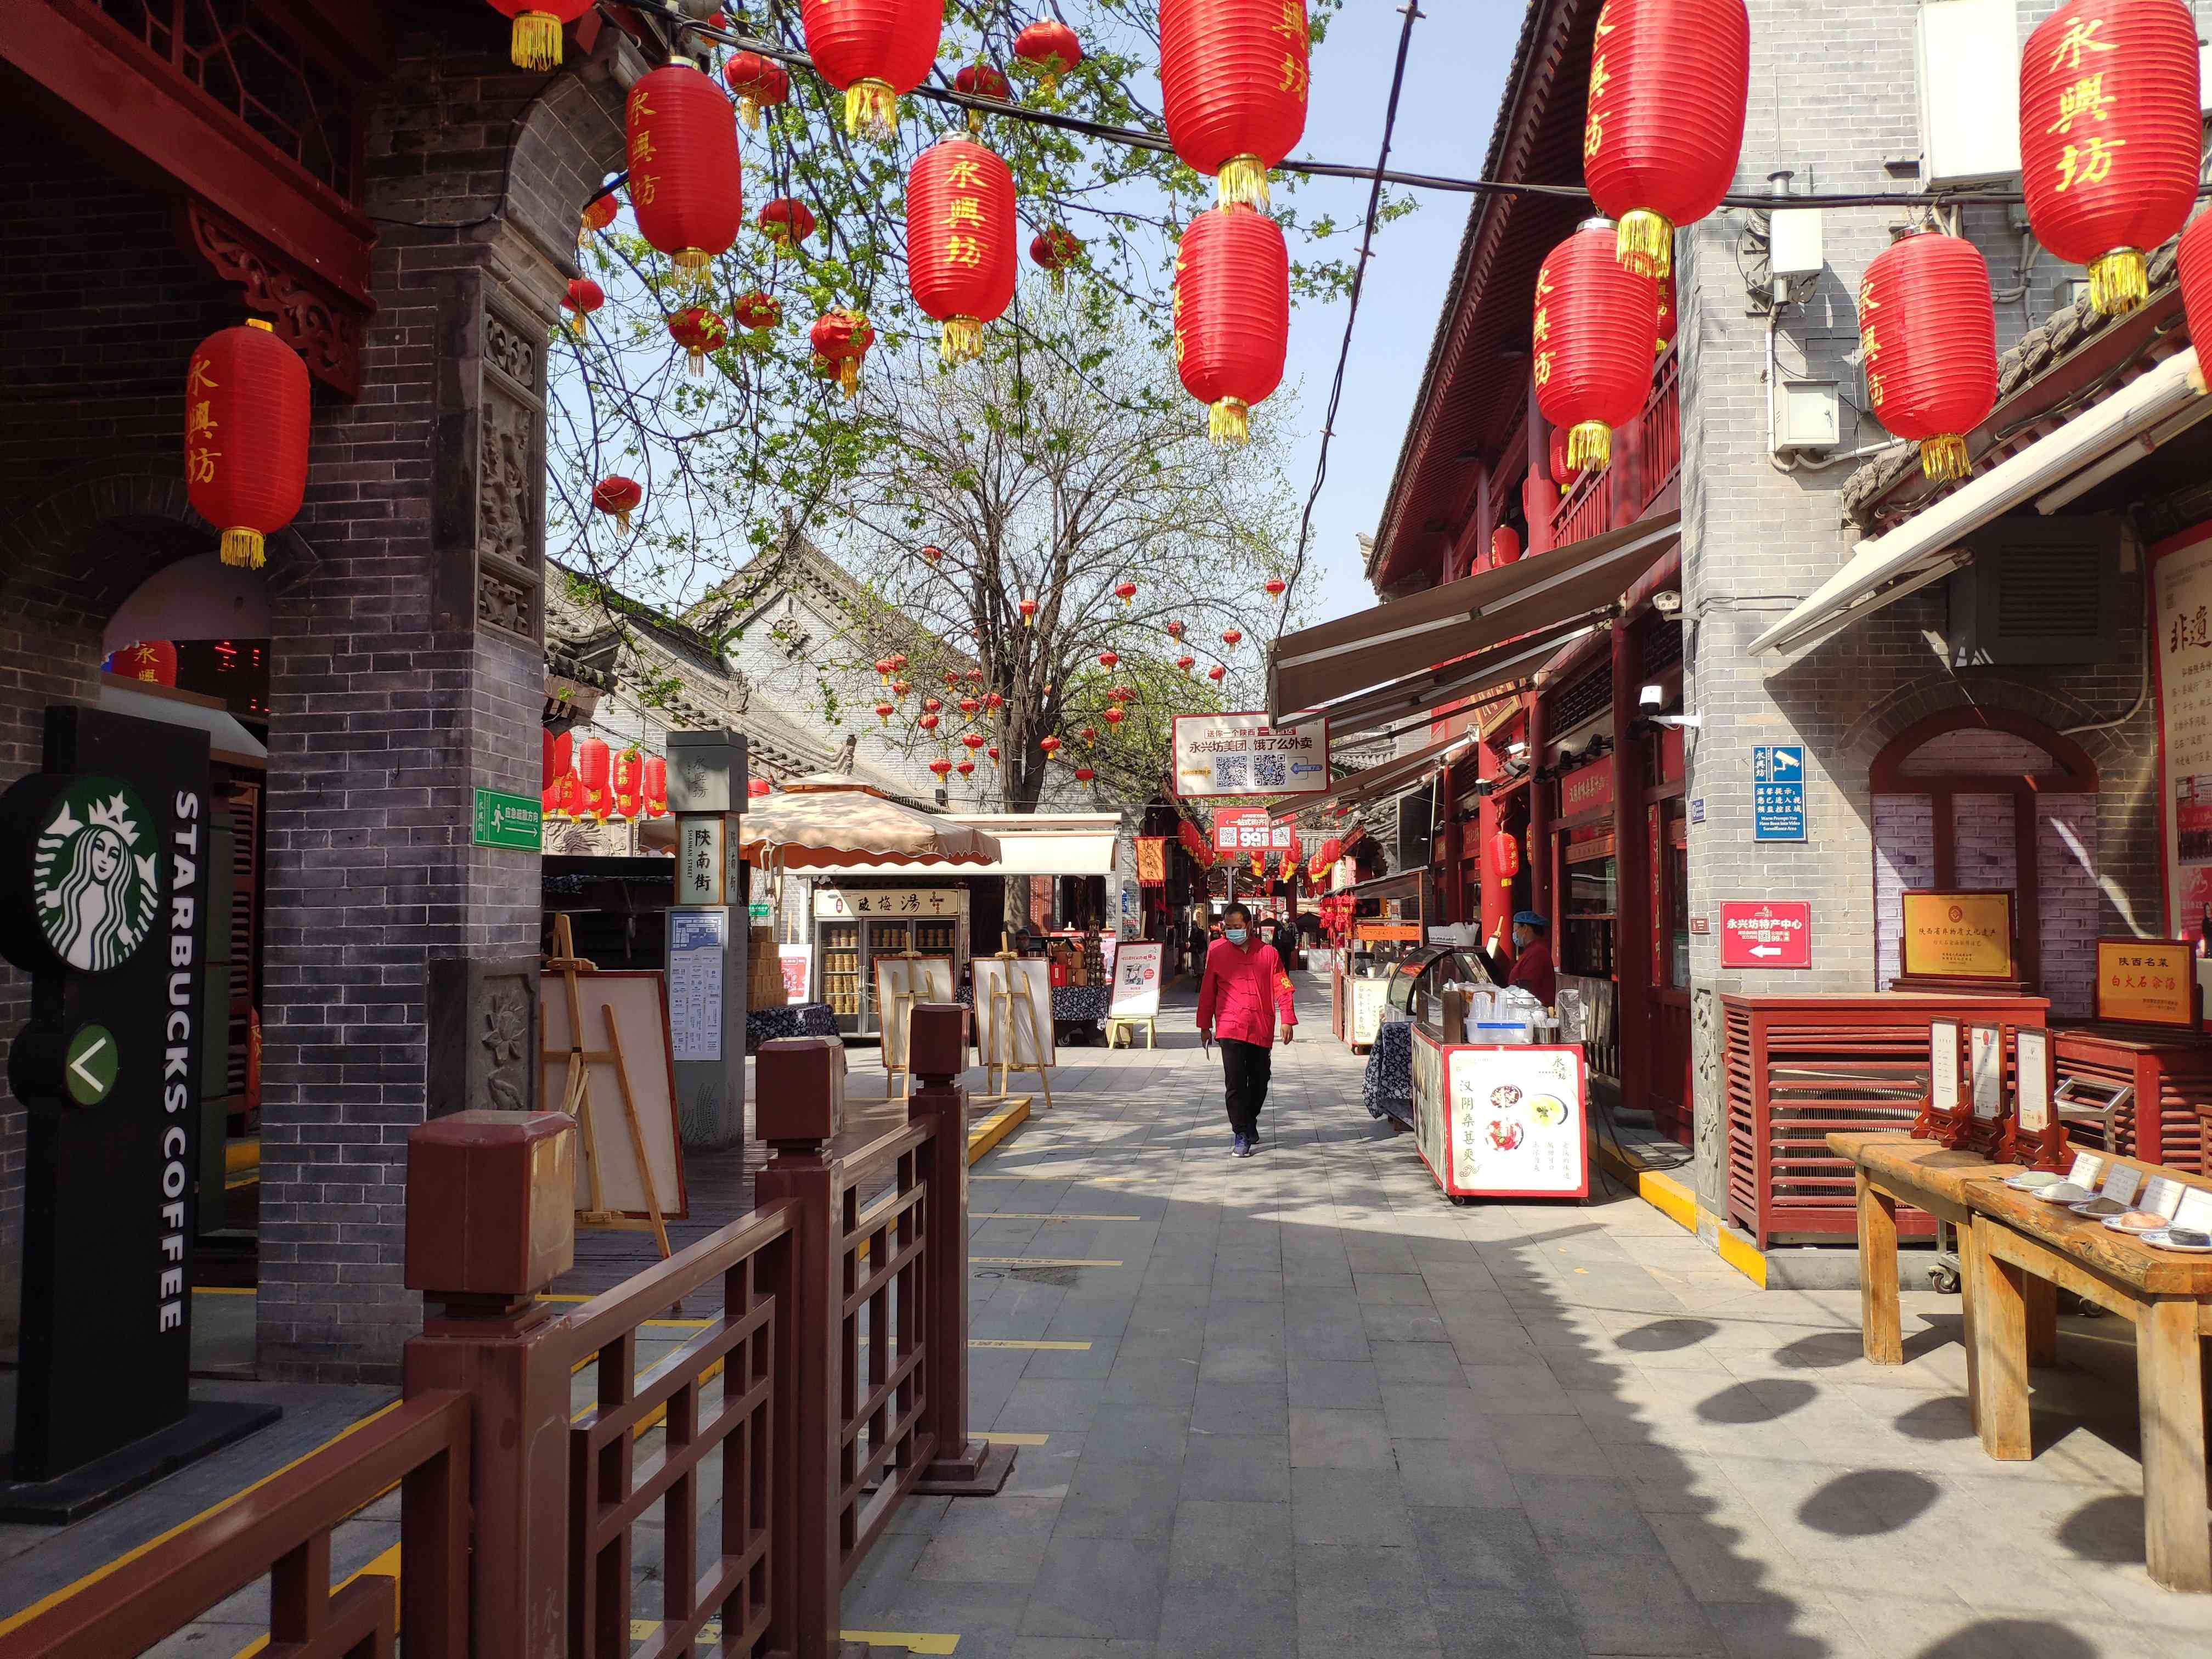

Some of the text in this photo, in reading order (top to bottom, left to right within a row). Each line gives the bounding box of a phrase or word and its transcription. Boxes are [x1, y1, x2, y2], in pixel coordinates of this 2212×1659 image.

[2047, 16, 2126, 192] 永興坊
[630, 88, 661, 209] 永興坊
[940, 154, 987, 270] 永興坊
[189, 354, 222, 484] 永興坊
[1189, 737, 1313, 753] 永兴坊美团、饿了么外卖
[1756, 750, 1766, 777] 永興坊
[693, 755, 709, 798] 永興坊
[1757, 796, 1802, 804] 您已进入视
[694, 828, 712, 891] 陝南街
[1726, 918, 1803, 929] 永兴坊特产中心
[1918, 926, 1996, 938] 陕西省非物质文化遗产
[2118, 957, 2169, 967] 陕西名菜
[160, 790, 199, 1333] STARBUCKS COFFEE
[1459, 1080, 1475, 1162] 汉阴桑葚爽
